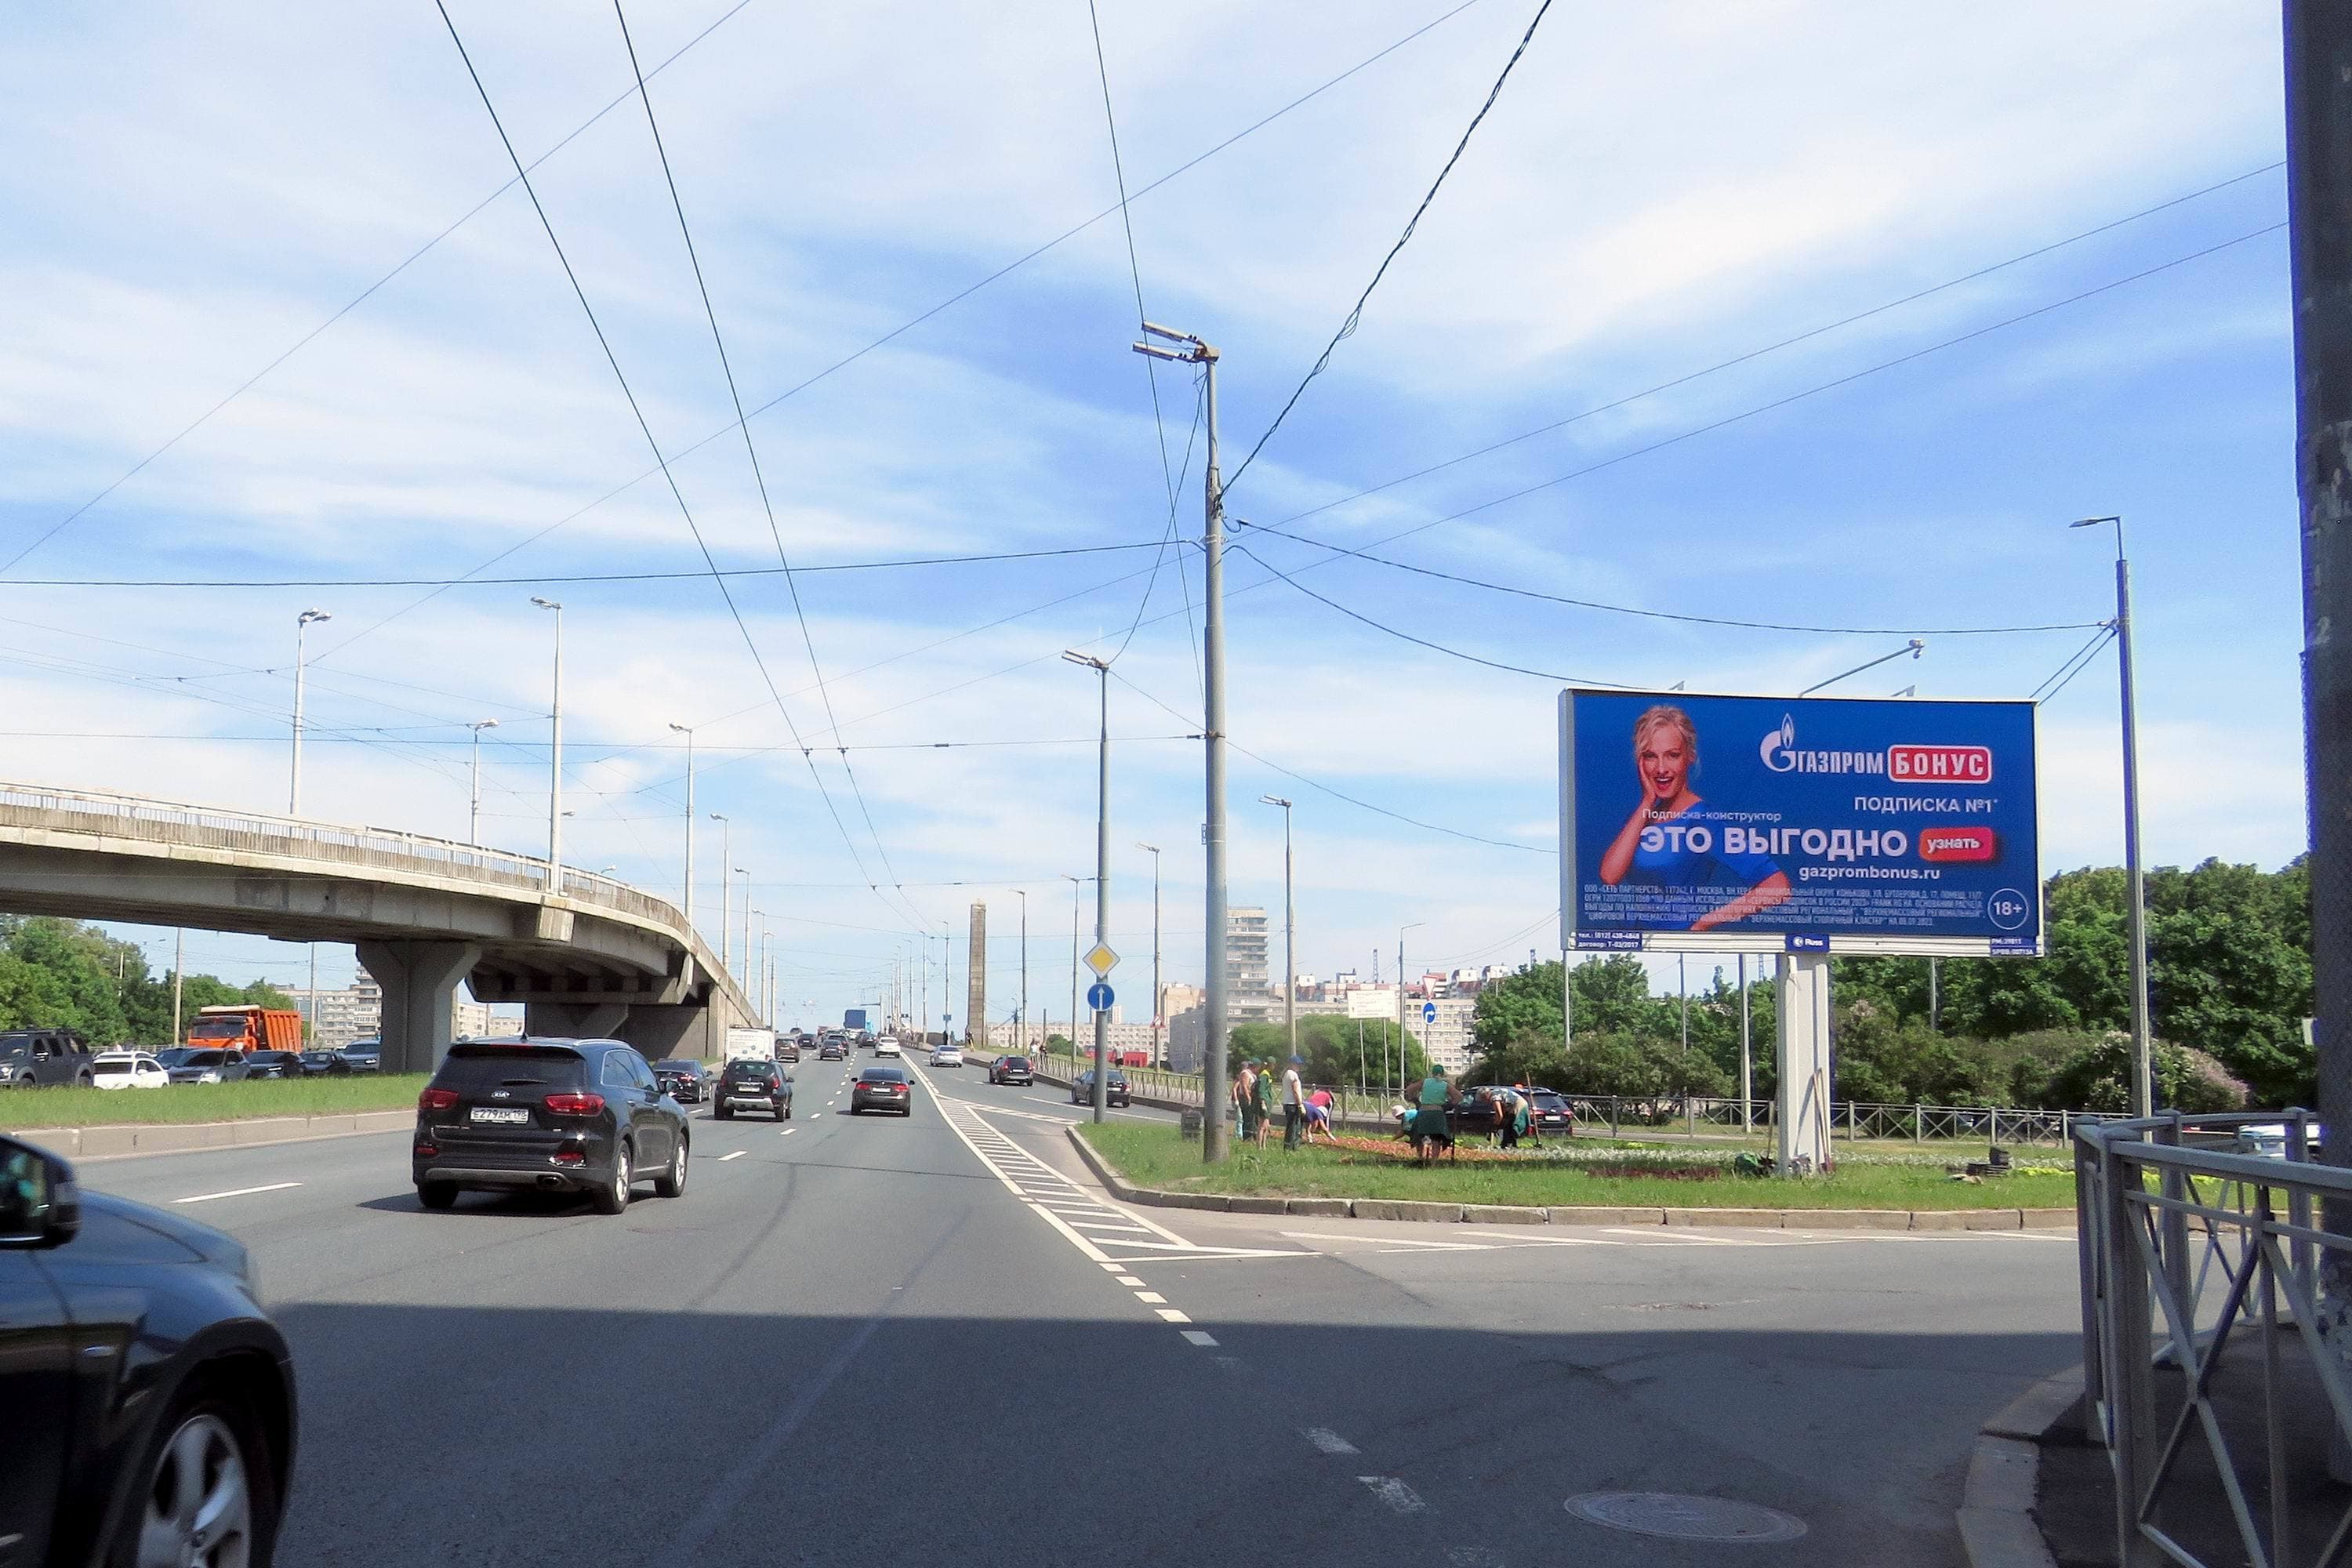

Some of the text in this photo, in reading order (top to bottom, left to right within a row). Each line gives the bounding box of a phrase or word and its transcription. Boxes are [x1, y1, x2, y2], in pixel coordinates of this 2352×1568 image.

[1895, 753, 1985, 776] БОНУС
[1854, 797, 1960, 814] ПОДПИСКА
[1642, 808, 1782, 822] Подписка-конструктор
[1639, 826, 1907, 862] ЭТО ВЫГОДНО
[1927, 837, 1982, 854] узнать
[1798, 865, 1940, 881] gazprombonus.ru
[1994, 902, 2022, 916] 18+
[1805, 938, 1824, 946] Russ
